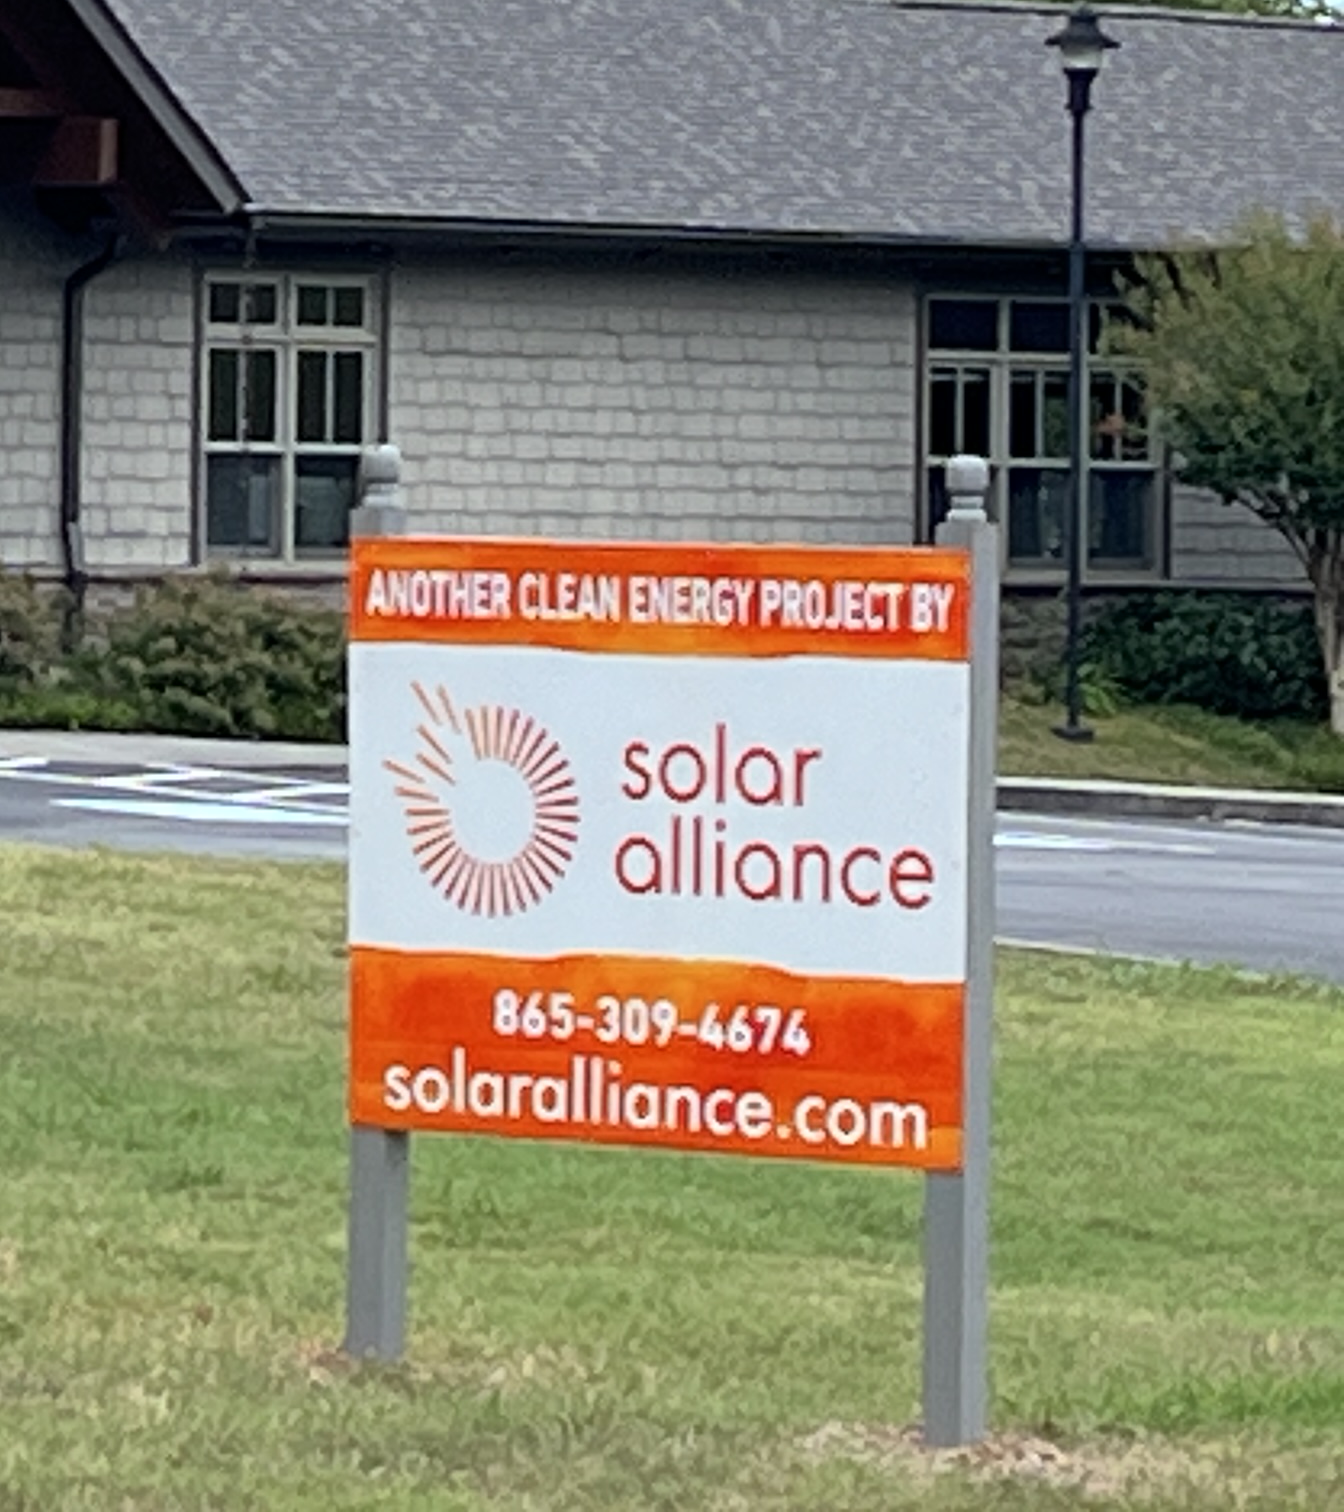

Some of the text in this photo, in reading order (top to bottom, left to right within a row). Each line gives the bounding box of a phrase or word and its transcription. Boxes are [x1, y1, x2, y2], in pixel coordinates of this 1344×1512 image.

[366, 569, 954, 633] ANOTHER CLEAN ENERGY PROJECT BY
[621, 722, 823, 806] solar
[614, 814, 935, 909] alliance
[492, 989, 811, 1056] 865-309-4674
[383, 1047, 928, 1149] solaralliance.com
